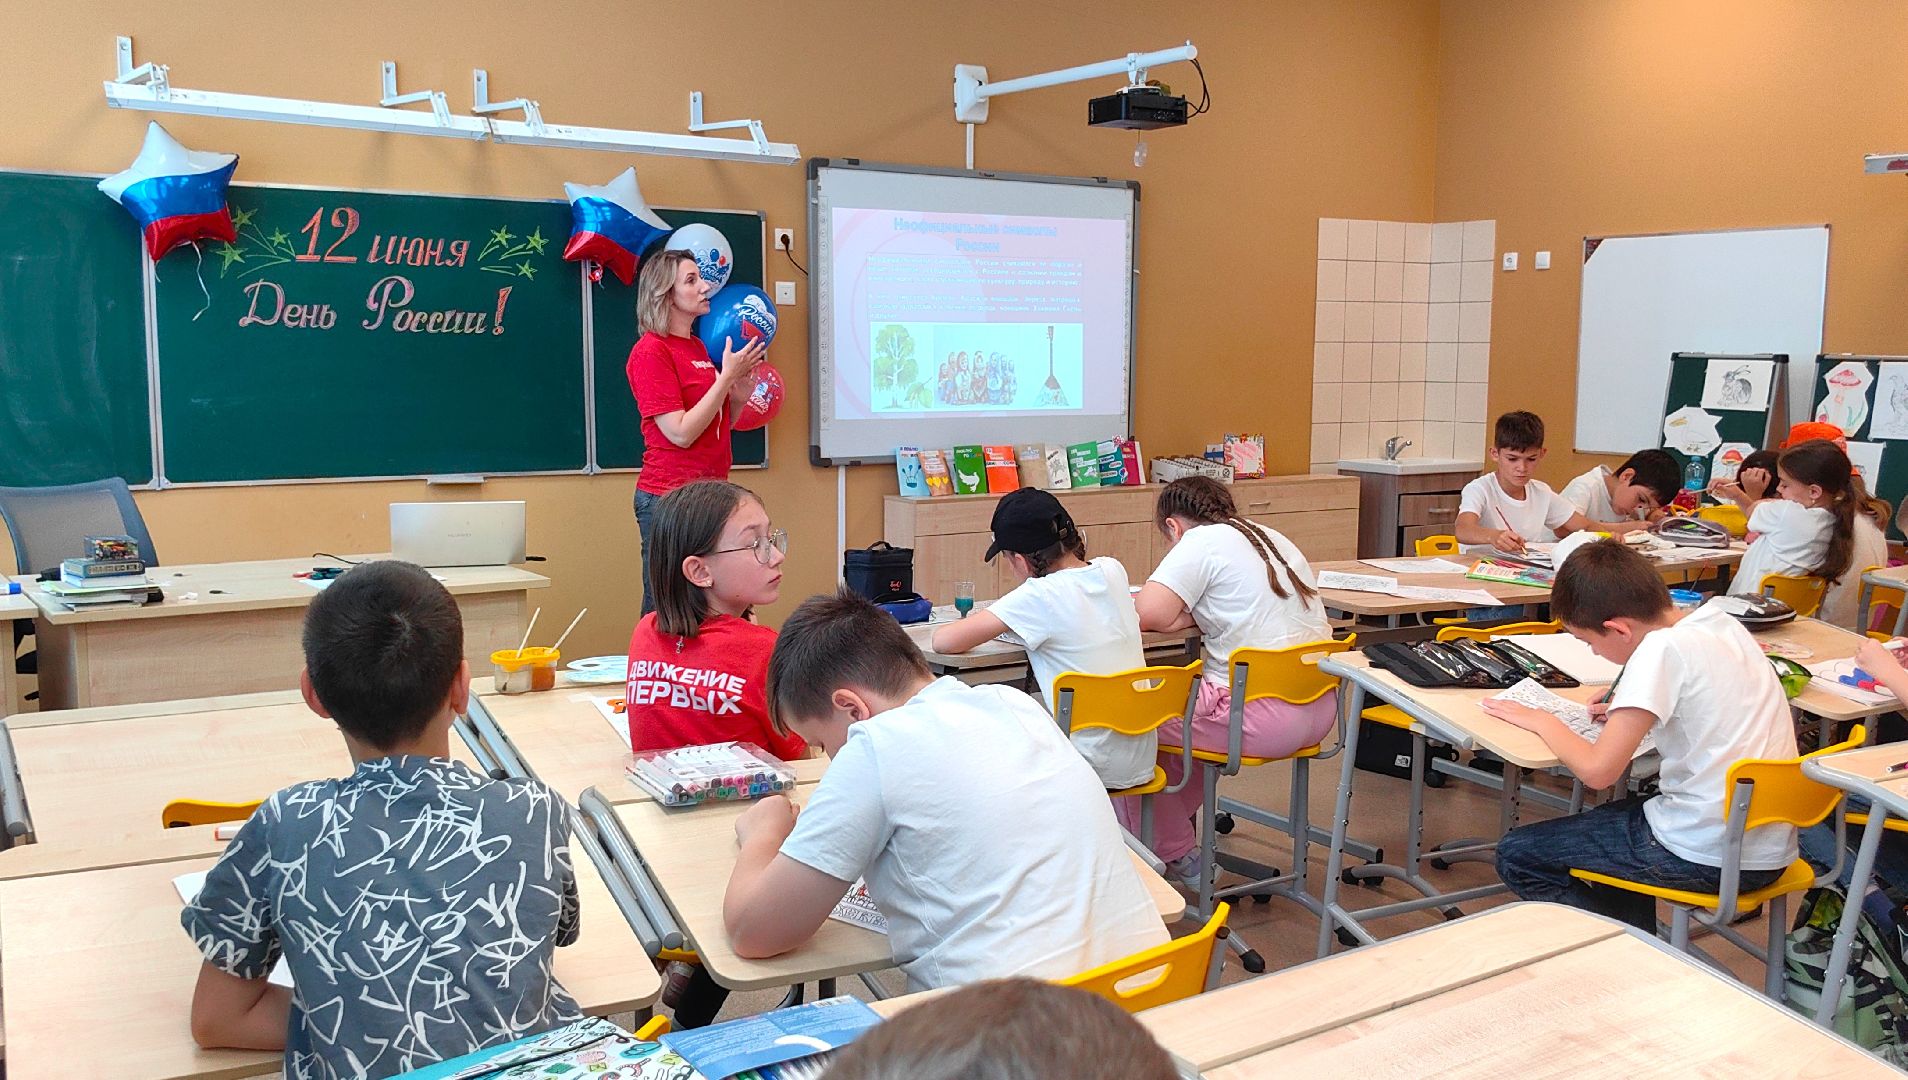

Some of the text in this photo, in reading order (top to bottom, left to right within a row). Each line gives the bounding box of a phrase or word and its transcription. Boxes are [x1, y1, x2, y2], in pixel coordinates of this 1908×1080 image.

[296, 206, 471, 268] 12 июня
[238, 274, 513, 336] День России!
[626, 680, 743, 715] ПЕРВЫХ
[629, 660, 747, 695] ДВИЖЕНИЕ
